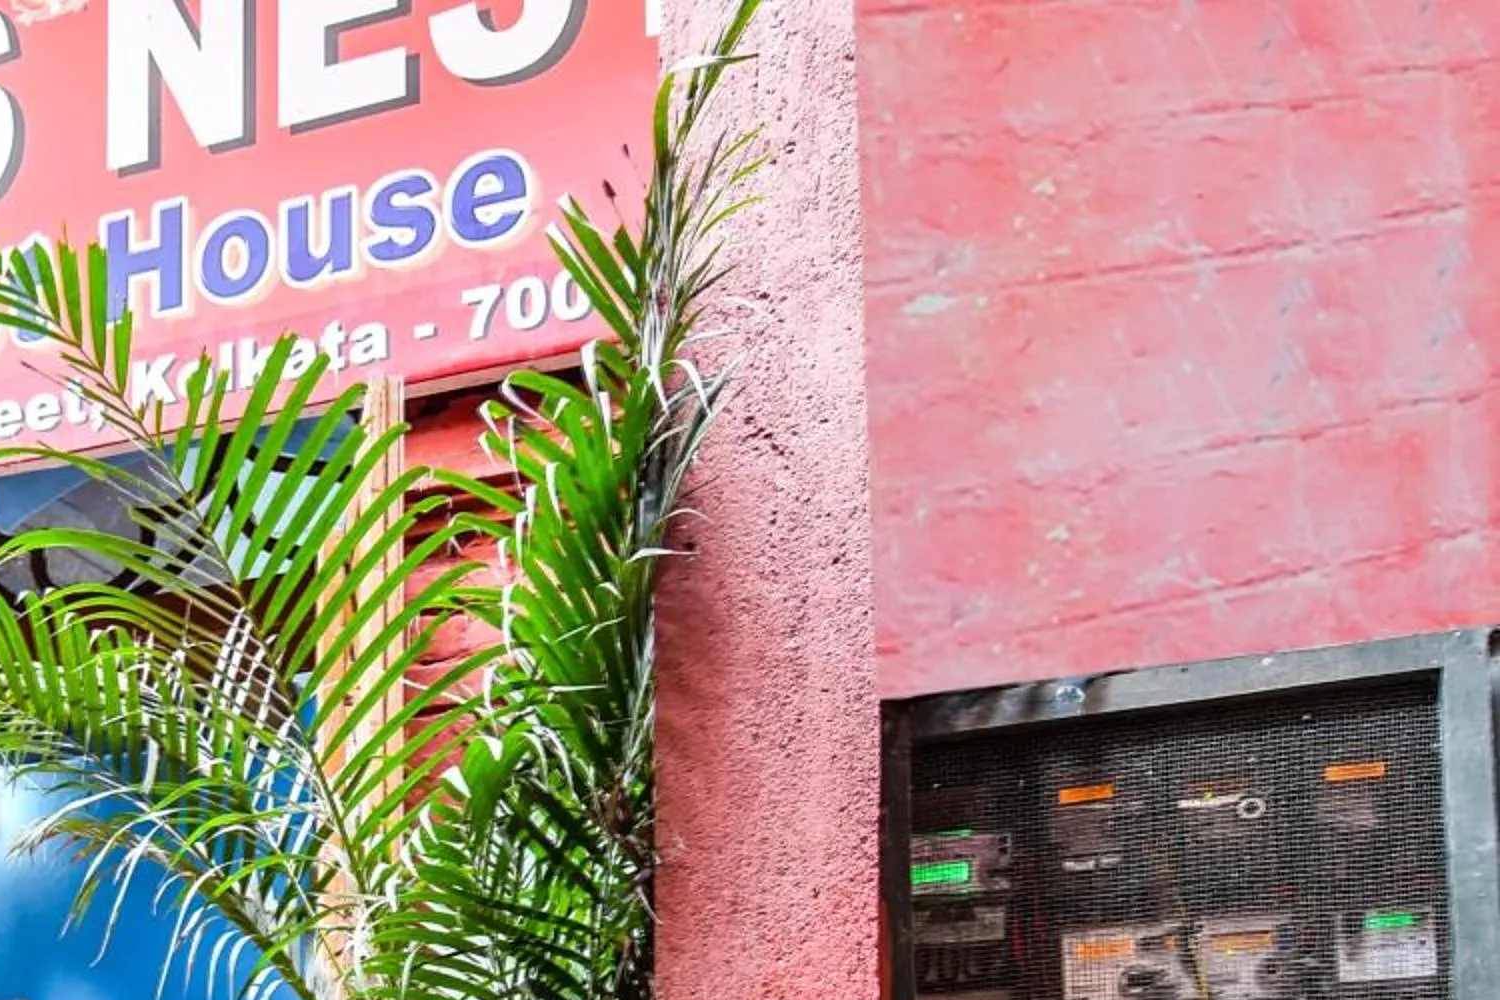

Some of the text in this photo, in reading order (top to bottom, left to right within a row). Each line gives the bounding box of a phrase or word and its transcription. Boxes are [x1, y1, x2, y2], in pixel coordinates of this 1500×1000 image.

[98, 148, 528, 326] House
[132, 320, 389, 413] Kolkata
[460, 268, 592, 338] 700
